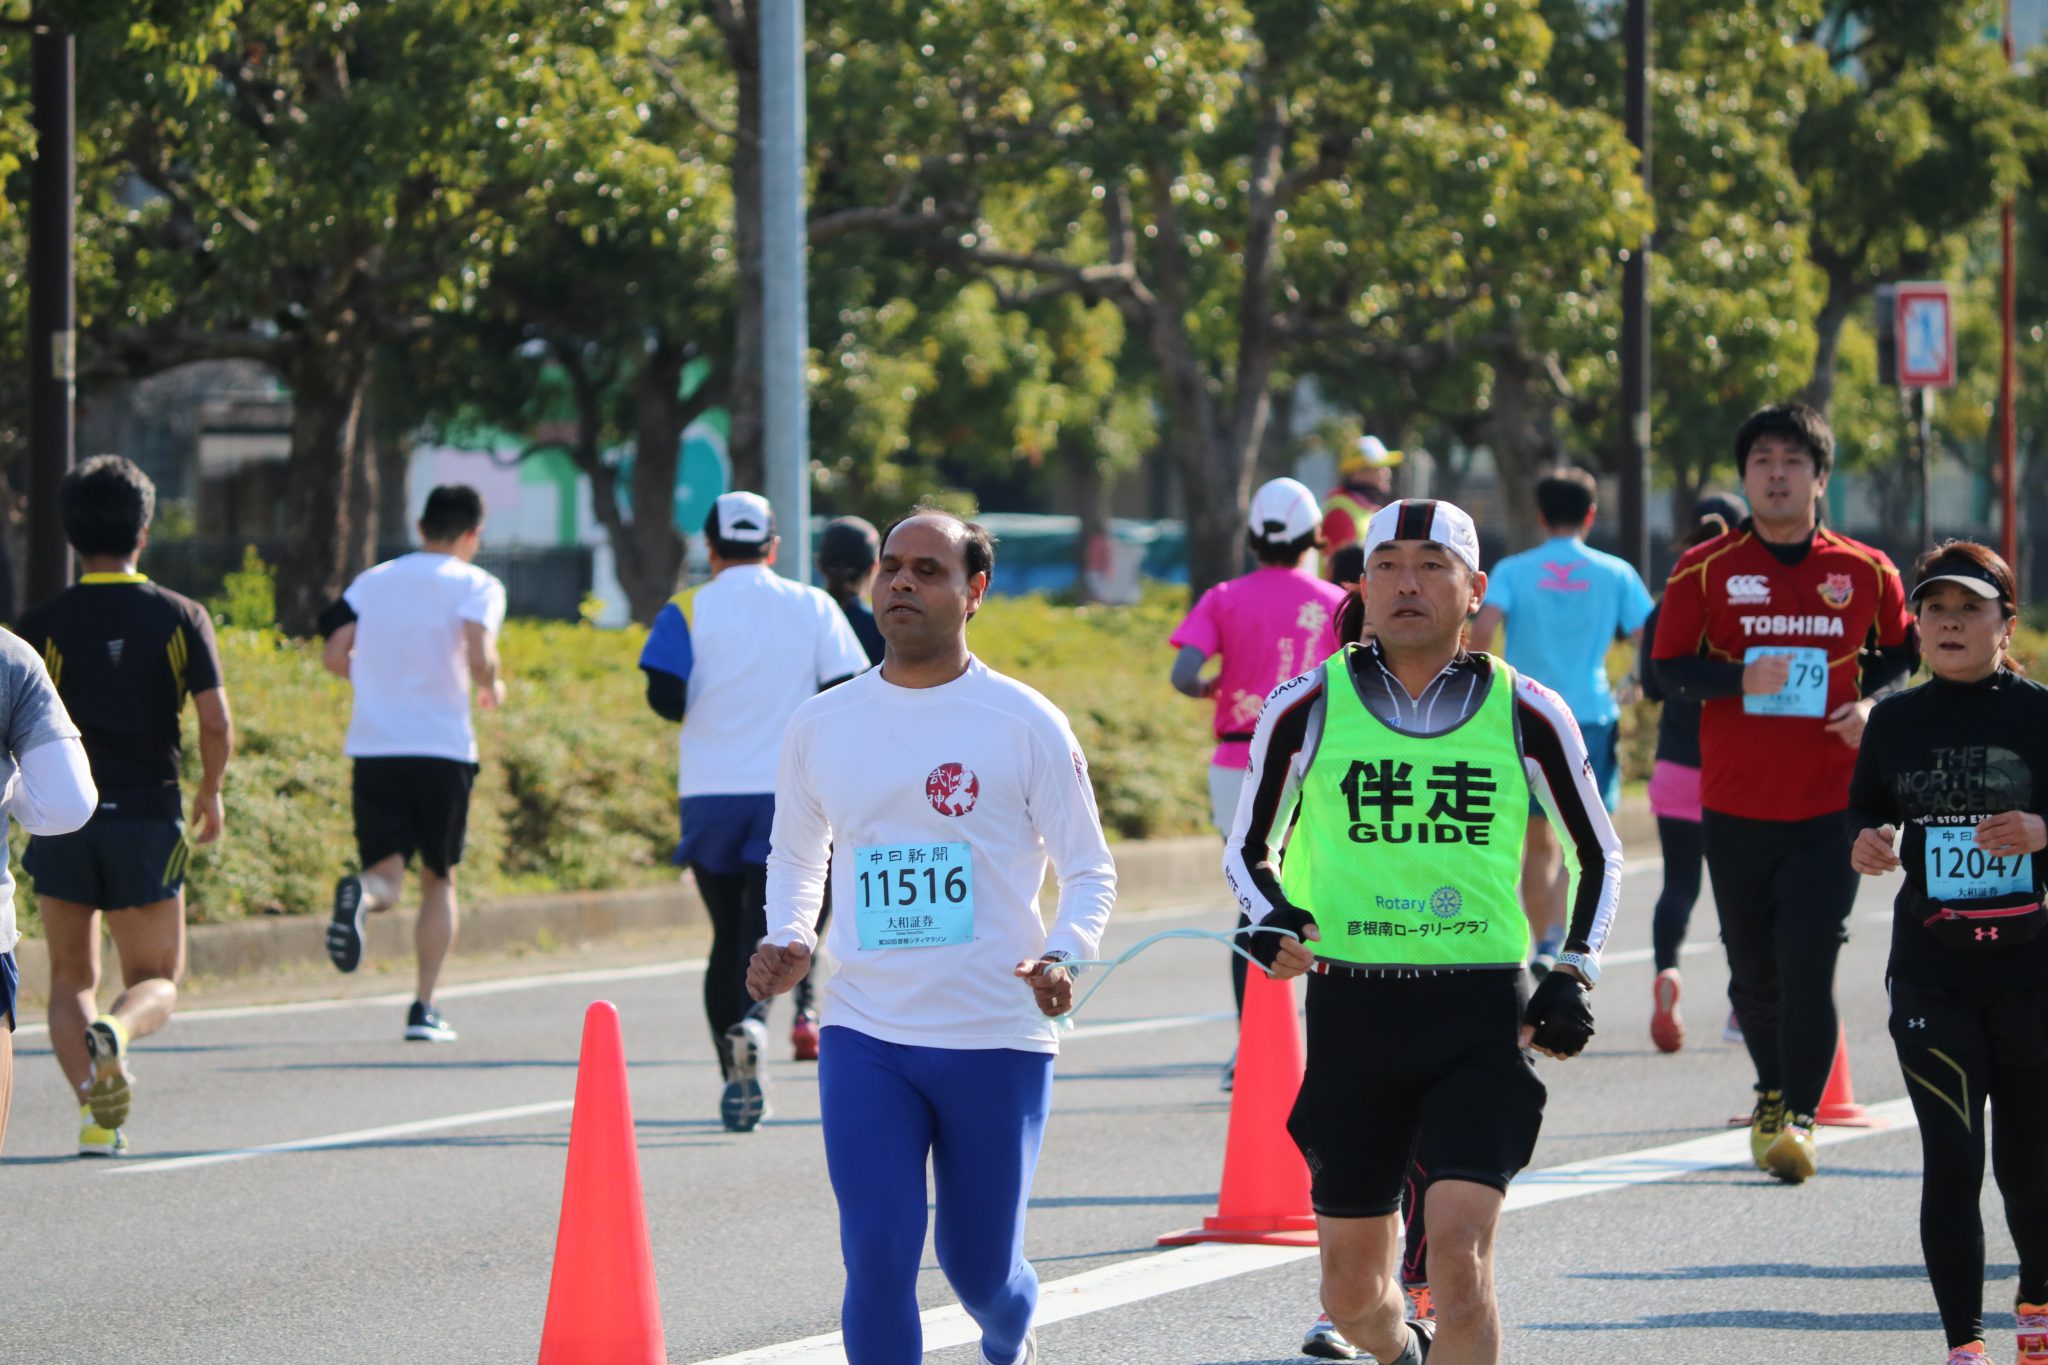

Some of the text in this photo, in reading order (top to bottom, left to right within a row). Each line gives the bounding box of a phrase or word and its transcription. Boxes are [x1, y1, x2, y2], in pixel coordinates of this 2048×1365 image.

[1739, 615, 1844, 637] TOSHIBA
[1932, 746, 1985, 769] THE
[927, 768, 947, 809] 武神
[1339, 759, 1497, 822] 伴走
[1897, 769, 1984, 794] NORTH
[1937, 814, 1966, 824] STOP
[1348, 823, 1490, 845] GUIDE
[870, 846, 948, 865] 中日新聞
[1931, 847, 2026, 879] 12047
[860, 866, 967, 908] 11516
[1957, 886, 1999, 898] 大和証券
[1375, 895, 1426, 913] Rotary
[887, 915, 934, 929] 大和証券
